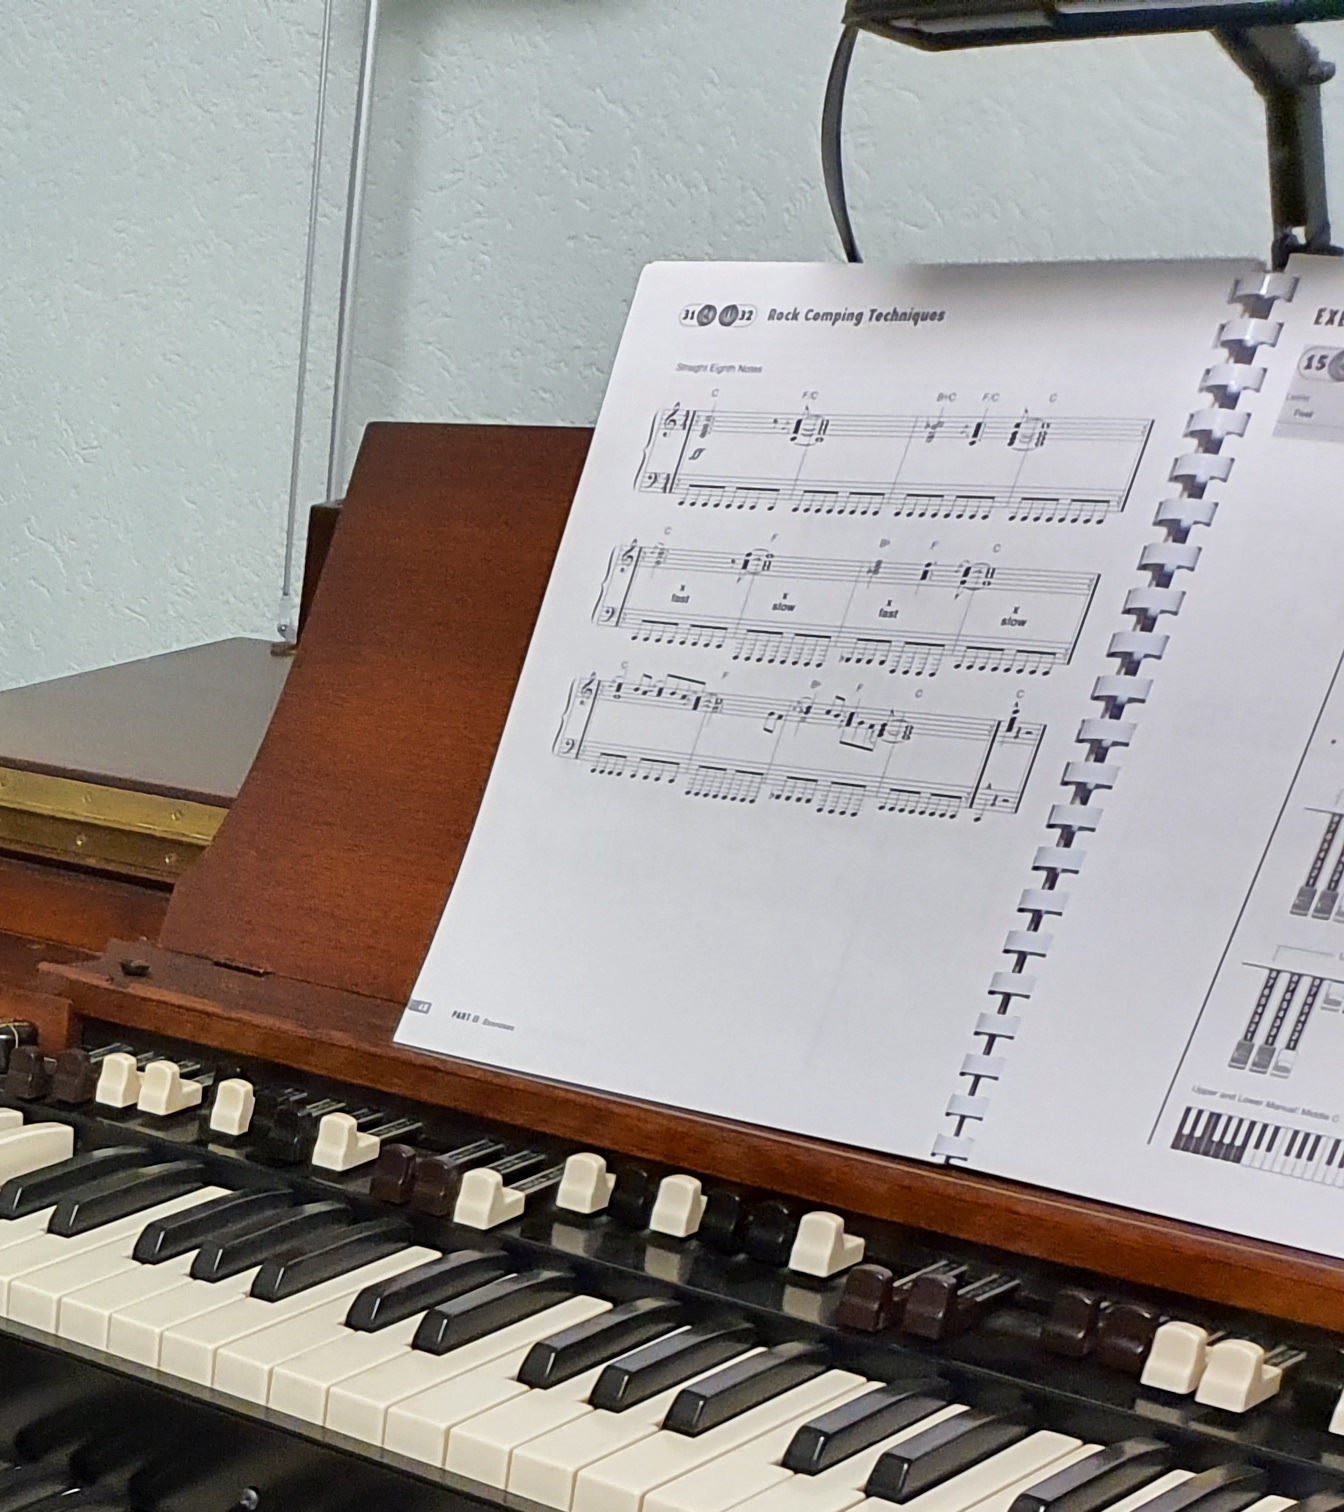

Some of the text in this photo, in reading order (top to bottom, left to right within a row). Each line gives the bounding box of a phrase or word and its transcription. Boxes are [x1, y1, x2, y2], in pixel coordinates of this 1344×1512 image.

[682, 307, 946, 327] 31 32 Rock Comping Techniques
[1303, 354, 1329, 371] 15
[671, 593, 1028, 628] fast slow fast slow
[451, 1010, 472, 1021] PART
